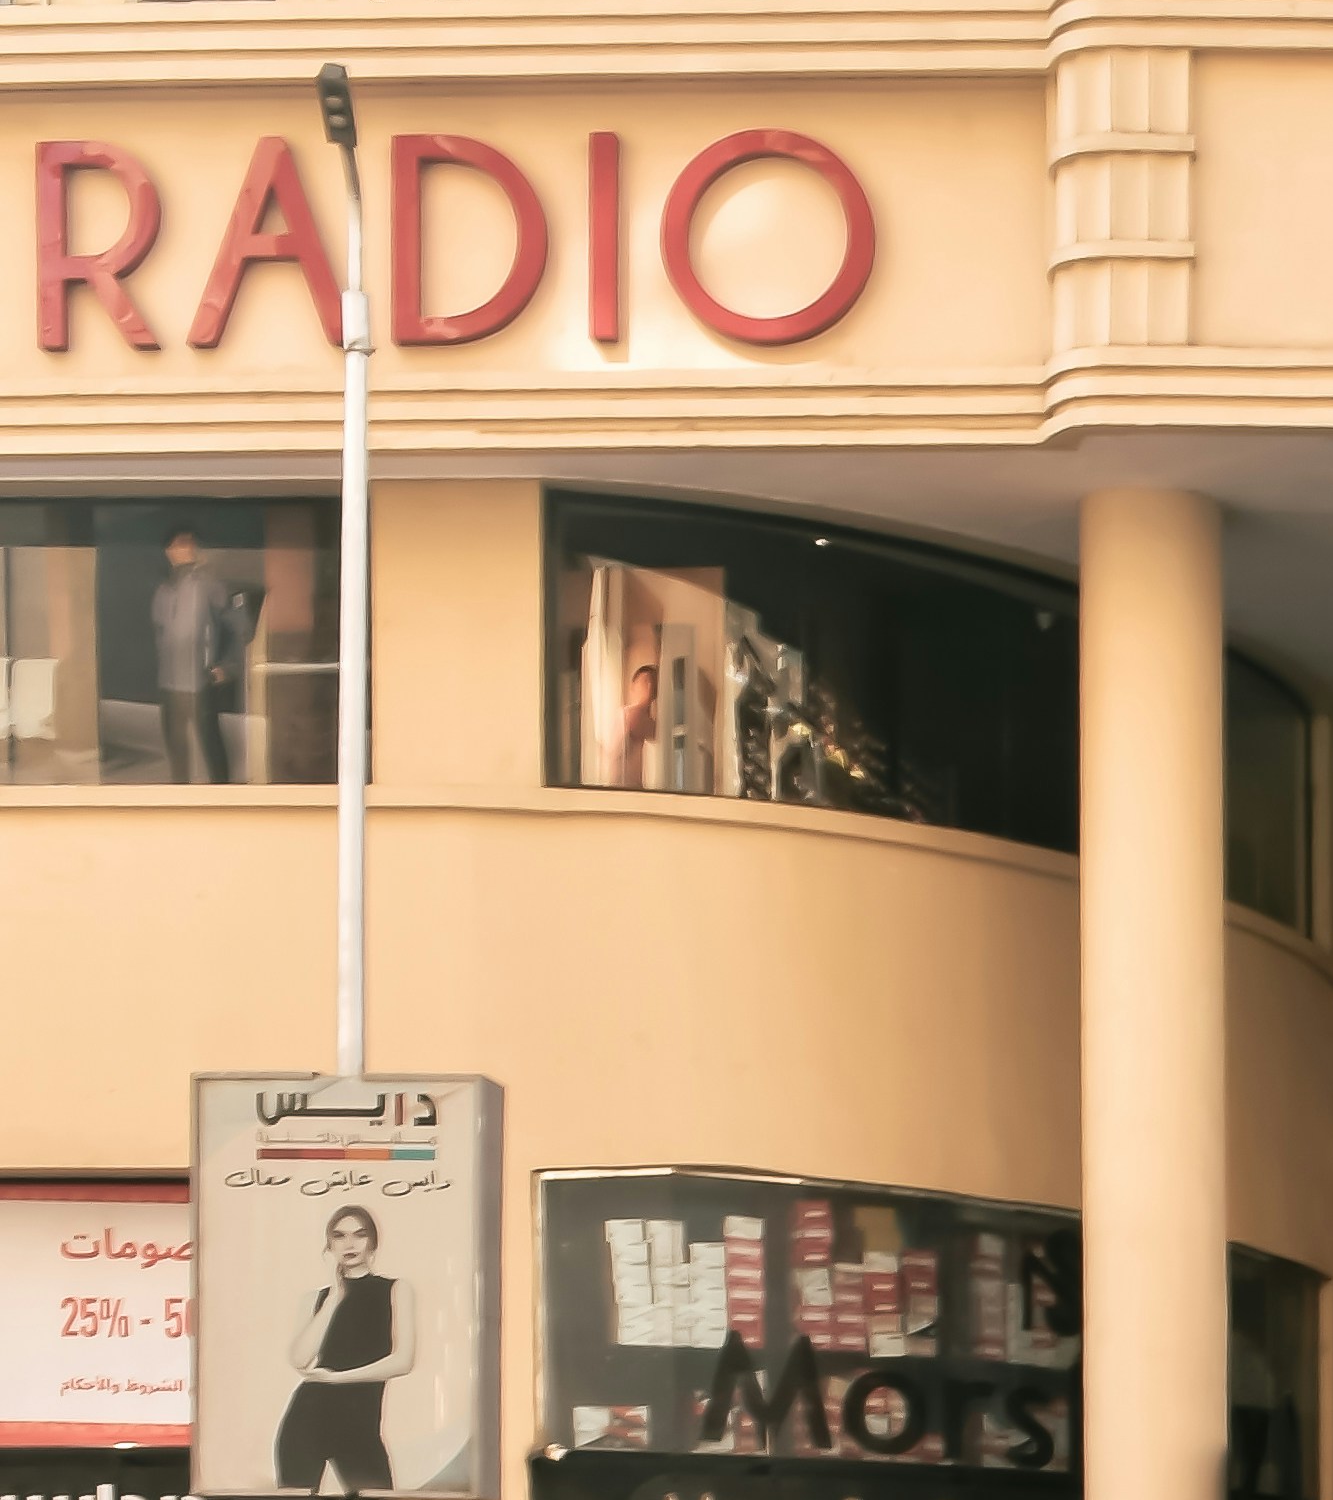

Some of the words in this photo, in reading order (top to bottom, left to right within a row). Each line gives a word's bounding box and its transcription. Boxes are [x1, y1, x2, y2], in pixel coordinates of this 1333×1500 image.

[36, 128, 877, 354] RADIO
[256, 1092, 438, 1126] دايس
[60, 1296, 130, 1338] 25%
